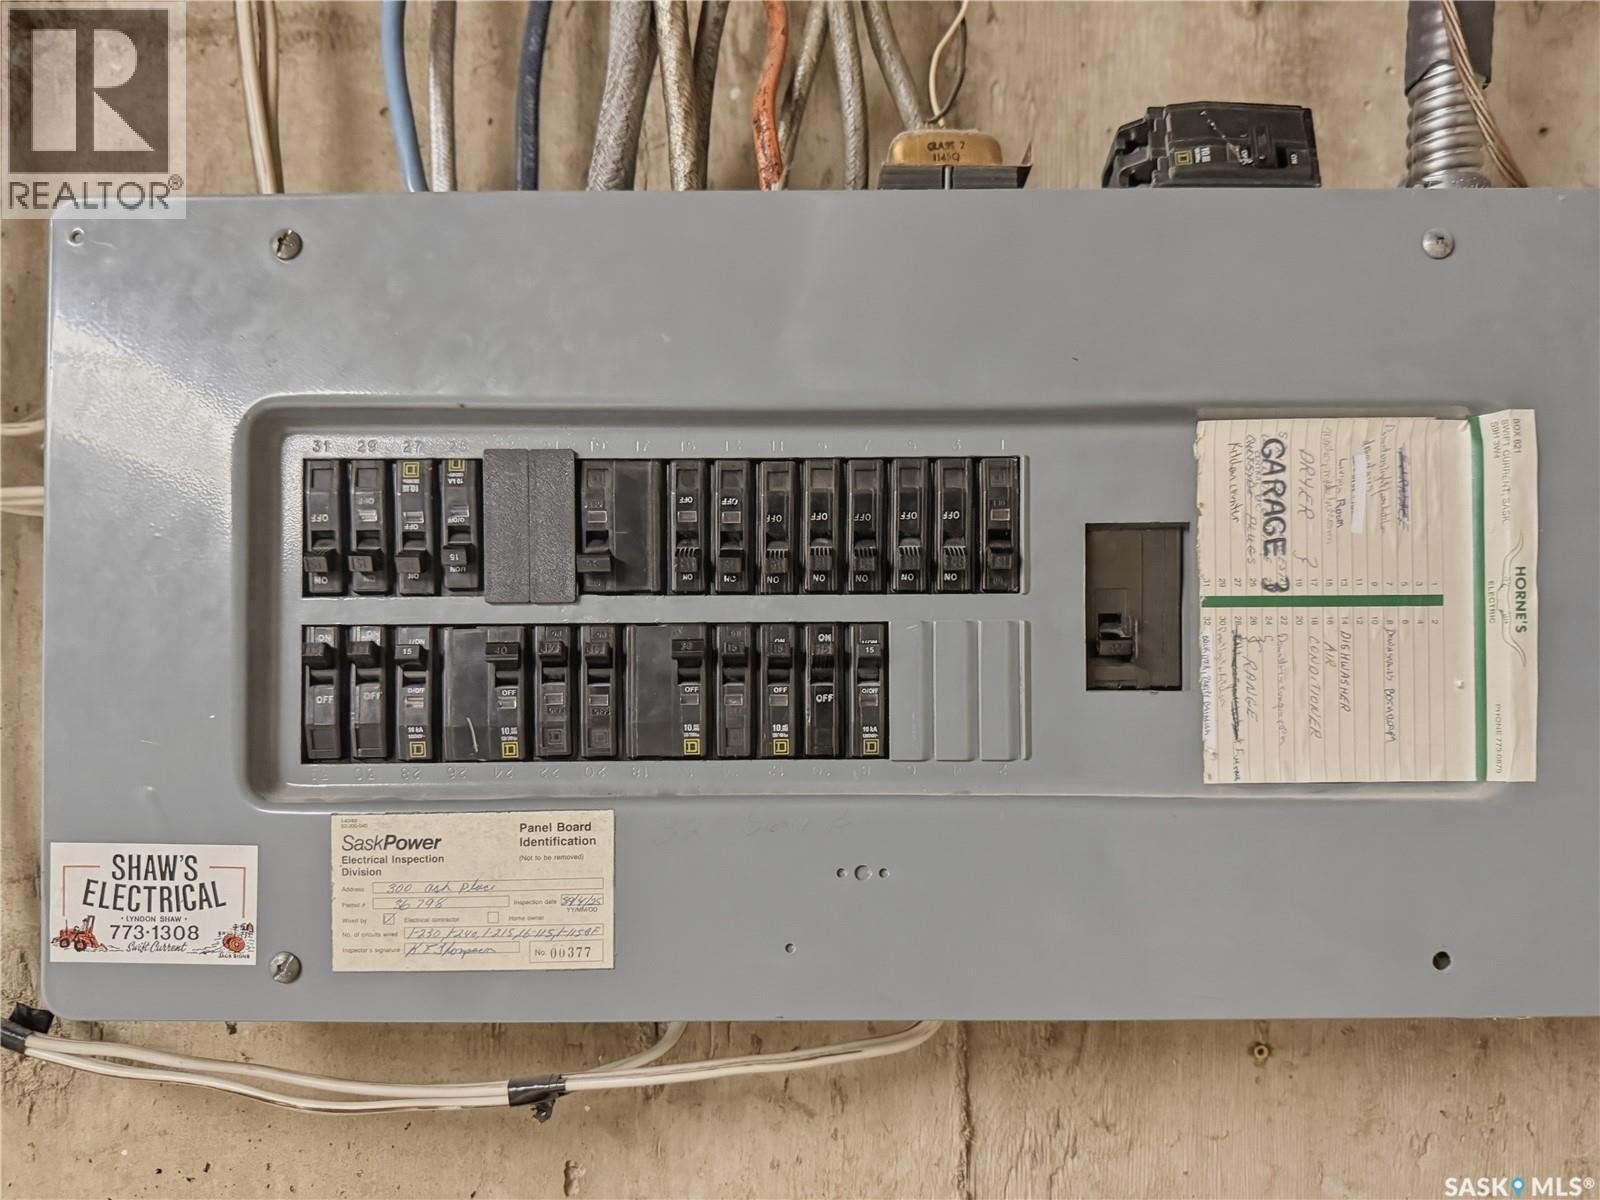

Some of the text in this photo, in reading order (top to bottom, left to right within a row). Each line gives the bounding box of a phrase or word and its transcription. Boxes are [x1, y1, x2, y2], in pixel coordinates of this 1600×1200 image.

[1297, 449, 1315, 520] DRYER
[721, 497, 739, 506] OFF
[1261, 438, 1287, 557] GARAGE
[311, 513, 329, 522] OFF
[766, 513, 783, 523] OFF
[811, 511, 828, 521] OFF
[854, 512, 872, 522] OFF
[900, 511, 918, 520] OFF
[943, 511, 960, 520] OFF
[1336, 498, 1347, 528] Room
[767, 575, 780, 584] ON
[813, 573, 826, 582] ON
[855, 574, 869, 583] ON
[901, 573, 914, 582] ON
[944, 573, 958, 582] ON
[1488, 580, 1496, 624] ELECTRIC
[1514, 565, 1527, 634] HORNE'S
[318, 634, 332, 642] ON
[818, 633, 832, 642] ON
[865, 646, 874, 654] 15
[1324, 641, 1337, 668] AIR
[1241, 656, 1259, 723] RANGE
[1308, 635, 1322, 740] CONDITIONER
[315, 696, 334, 704] OFF
[363, 692, 381, 700] OFF
[815, 694, 833, 703] OFF
[519, 822, 592, 834] Panel Board
[341, 834, 443, 852] SaskPower
[519, 836, 597, 848] Identification
[341, 854, 445, 866] Electrical Inspection
[518, 852, 585, 863] (Not to be removed)
[112, 853, 198, 882] SHAW'S
[341, 867, 382, 877] Division
[387, 882, 413, 894] 300
[82, 878, 227, 913] ELECTRICAL
[126, 940, 188, 954] Swift Current
[550, 946, 592, 959] 00377
